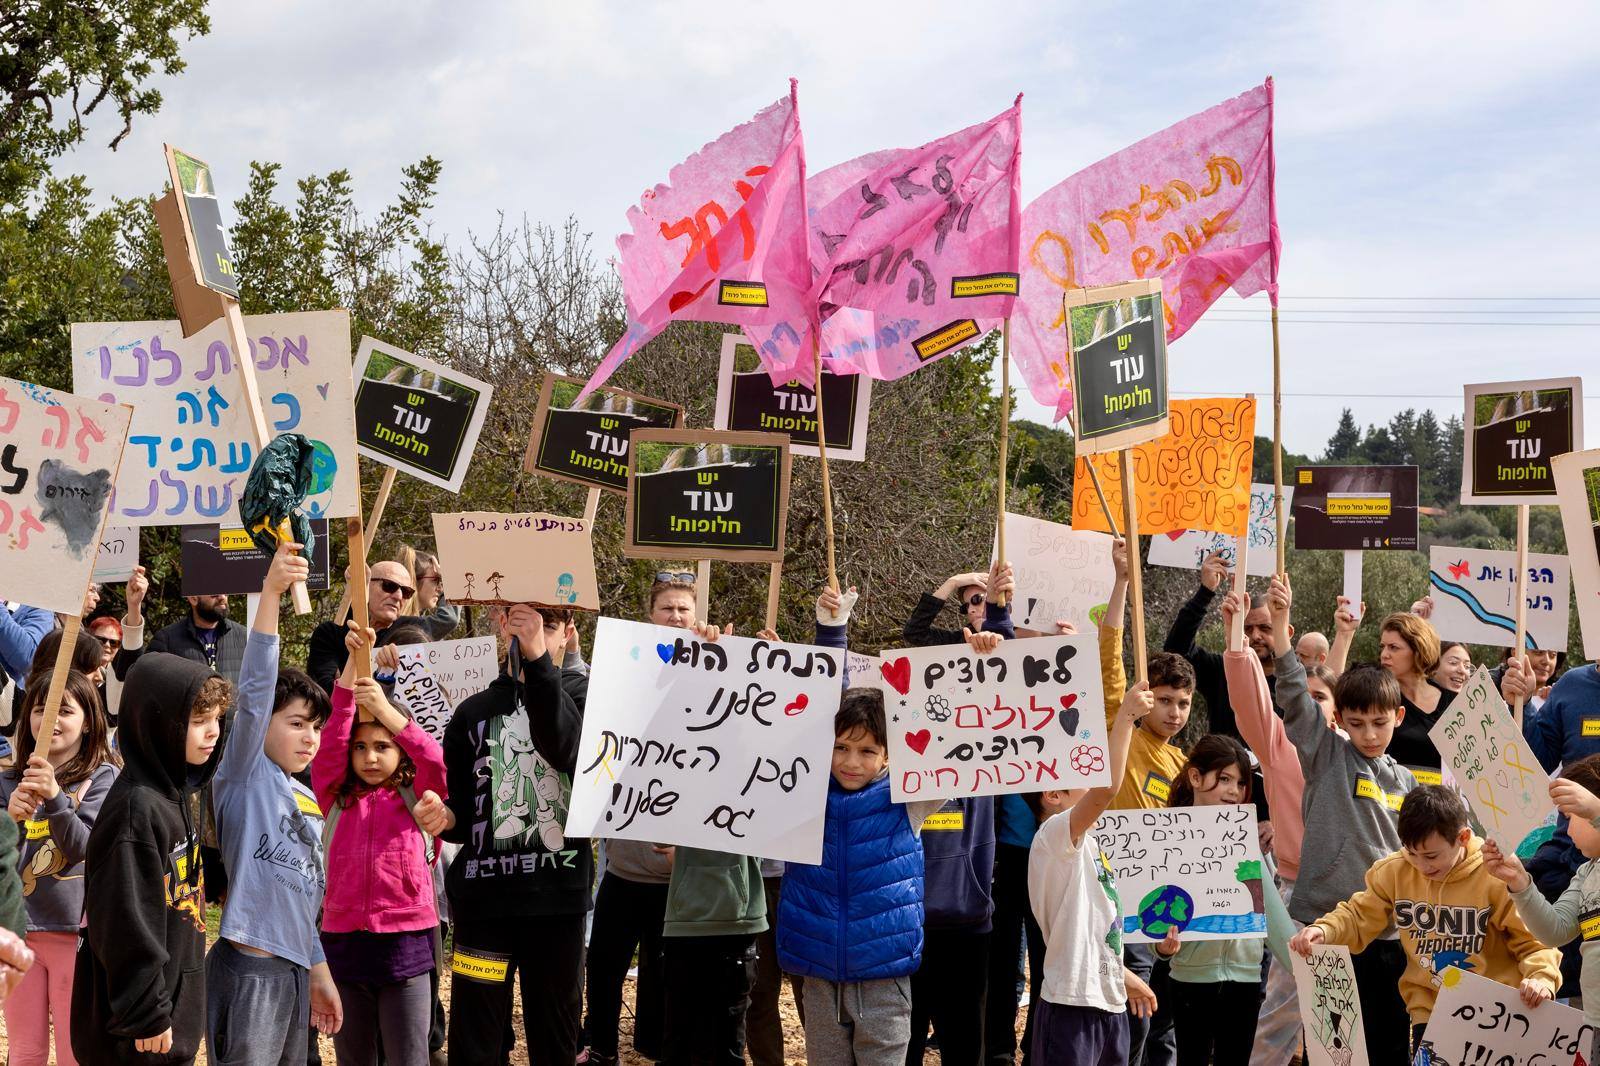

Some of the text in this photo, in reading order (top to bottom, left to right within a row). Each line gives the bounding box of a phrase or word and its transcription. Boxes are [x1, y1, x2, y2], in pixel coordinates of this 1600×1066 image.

[1117, 333, 1132, 351] יש
[99, 334, 310, 388] אכת לנו
[1110, 354, 1145, 385] עוד
[175, 384, 230, 427] זה
[407, 392, 425, 407] יש
[773, 390, 817, 413] עוד
[1104, 385, 1152, 414] חלופות!
[392, 404, 432, 434] עוד
[600, 417, 619, 430] יש
[760, 412, 819, 432] חלופות!
[1515, 420, 1531, 434] יש
[374, 422, 430, 457] חלופות!
[586, 430, 629, 457] עוד
[1506, 438, 1541, 460] עוד
[129, 435, 253, 473] עתיד
[570, 449, 629, 478] חלופות!
[697, 472, 719, 485] יש
[1497, 462, 1547, 481] חלופות!
[109, 468, 238, 518] שלנו
[683, 490, 734, 512] עוד
[1352, 503, 1364, 511] נחל
[458, 517, 497, 531] בנחל
[670, 515, 741, 534] חלופות!
[231, 536, 249, 544] פרוד
[1476, 565, 1503, 582] את
[454, 643, 492, 661] בנחל
[671, 637, 728, 672] הוא
[747, 640, 838, 678] הנחל
[924, 644, 1078, 690] לא רוצים
[685, 682, 776, 732] שלנו.
[1465, 684, 1488, 710] נחל
[954, 694, 1055, 731] לולים
[944, 735, 1046, 762] רוצים
[1453, 713, 1496, 770] את הלולים
[1485, 736, 1500, 763] לא
[582, 730, 810, 797] לכן האחריות
[902, 758, 1060, 794] איכות חיים
[605, 778, 755, 838] גם שלנו!
[1216, 804, 1249, 824] לא
[1143, 812, 1192, 827] רוצים
[1151, 829, 1206, 842] רוצים
[1221, 825, 1248, 842] לא
[253, 833, 290, 863] Wild
[1162, 847, 1183, 866] רק
[1201, 842, 1247, 859] רוצים
[1150, 865, 1169, 881] רק
[1178, 860, 1222, 875] רוצים
[1394, 899, 1494, 937] SONIC
[1409, 929, 1429, 940] THE
[1415, 934, 1487, 956] HEDGEHO
[460, 961, 472, 970] נחל
[472, 964, 484, 972] את
[1452, 1001, 1530, 1038] רוצים
[1548, 1024, 1594, 1056] לא
